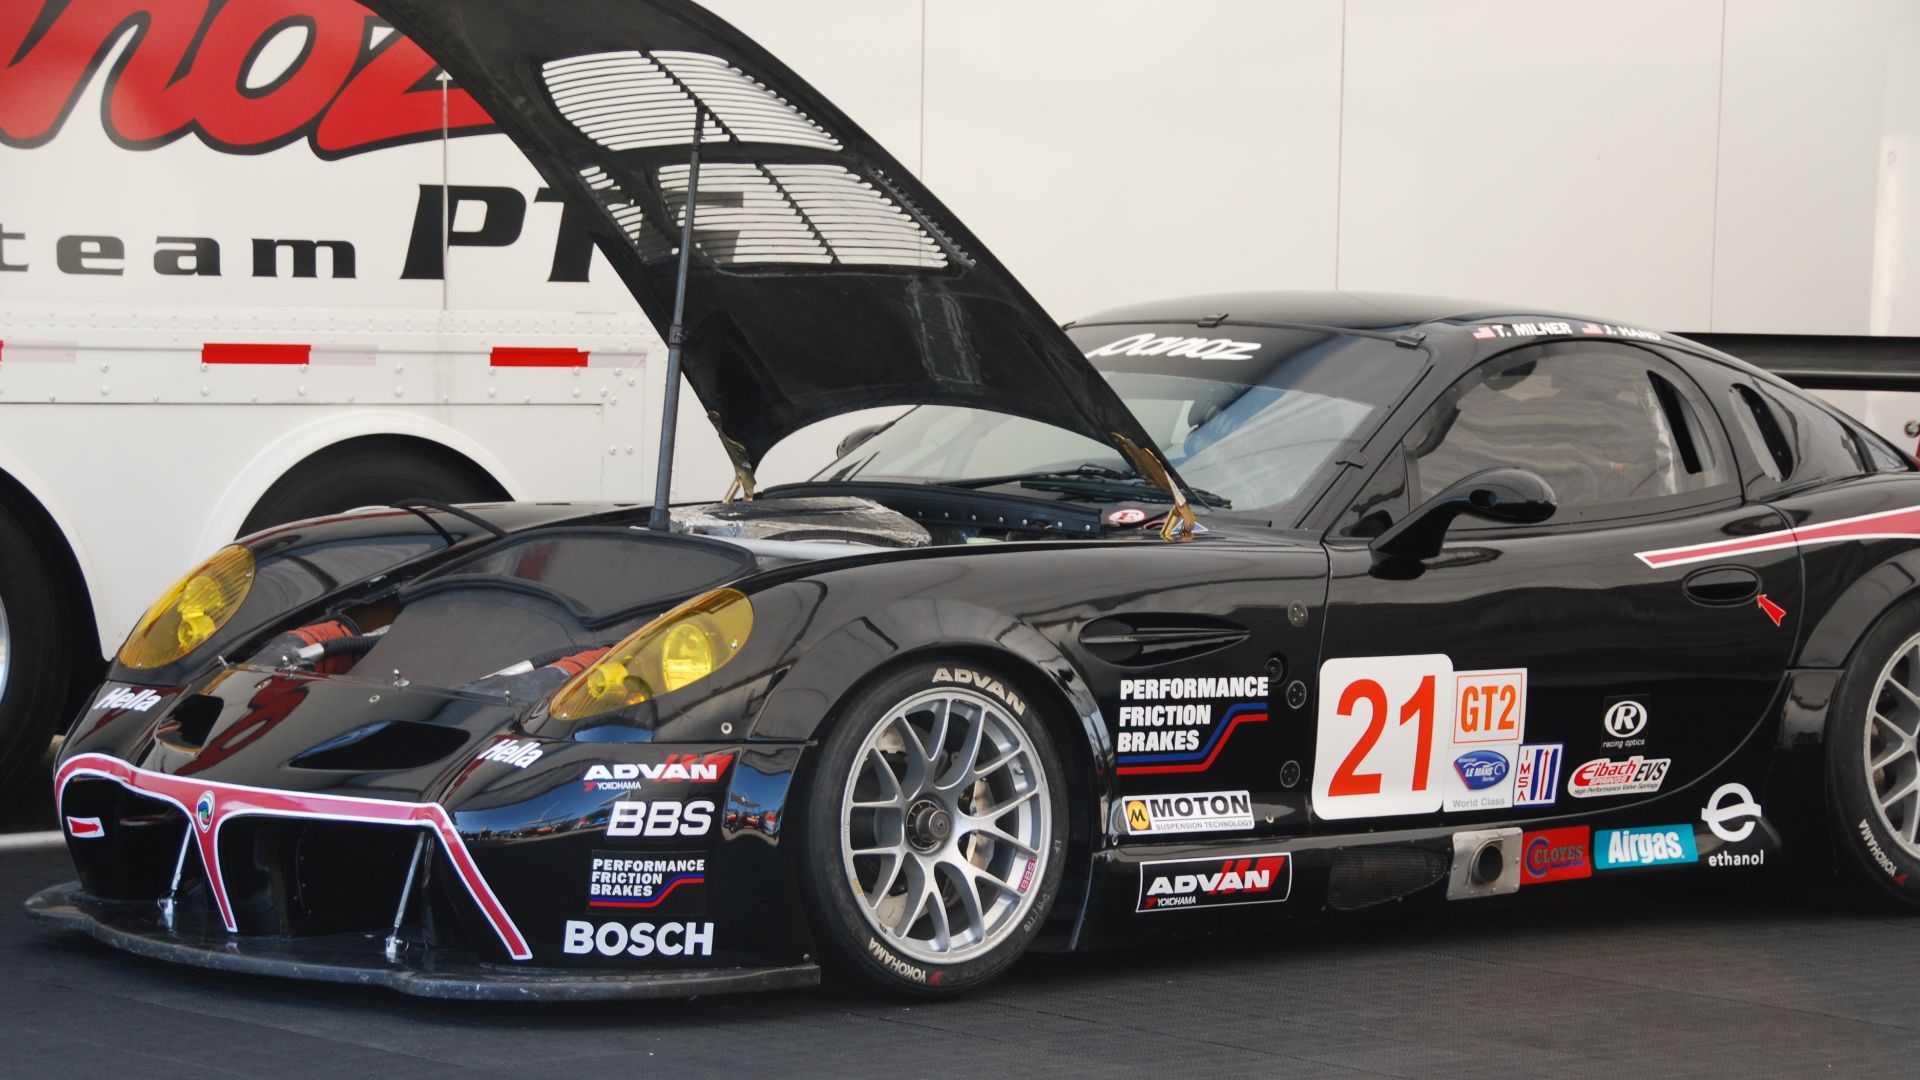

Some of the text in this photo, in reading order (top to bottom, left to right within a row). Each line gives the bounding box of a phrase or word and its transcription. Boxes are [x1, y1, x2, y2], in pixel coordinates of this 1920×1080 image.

[0, 0, 509, 161] noz
[1492, 322, 1573, 337] T. MILNER
[1617, 326, 1662, 341] HAND
[93, 687, 162, 712] Hella
[932, 667, 1026, 716] ADVAN
[1120, 676, 1269, 700] PERFORMANCE
[1119, 704, 1211, 727] FRICTION
[1461, 684, 1516, 733] GT2
[1117, 729, 1200, 752] BRAKES
[1328, 675, 1435, 797] 21
[1602, 738, 1645, 749] racing optics
[476, 739, 544, 769] Hella
[583, 763, 717, 780] ADVAN
[1465, 766, 1494, 778] LE MANS
[1574, 760, 1667, 786] Eibach EVS
[597, 781, 641, 790] YOKOHAMA
[1588, 785, 1621, 793] Performance
[1638, 782, 1659, 790] Springs
[1150, 794, 1250, 817] MOTON
[1452, 797, 1505, 808] World Class
[607, 801, 715, 837] BBS
[1155, 820, 1252, 831] SUSPENSION TECHNOLOGY
[1534, 845, 1584, 865] CLOYES
[1708, 849, 1764, 867] ethanol
[1858, 819, 1898, 877] YOKOHAMA
[592, 858, 705, 872] PERFORMANCE
[1020, 860, 1036, 890] BBS
[591, 871, 663, 885] FRICTION
[1147, 870, 1270, 896] ADVAN
[590, 884, 653, 897] BRAKES
[1157, 896, 1197, 907] YOKOHAMA
[563, 920, 715, 957] BOSCH
[868, 937, 926, 983] YOKOHAMA
